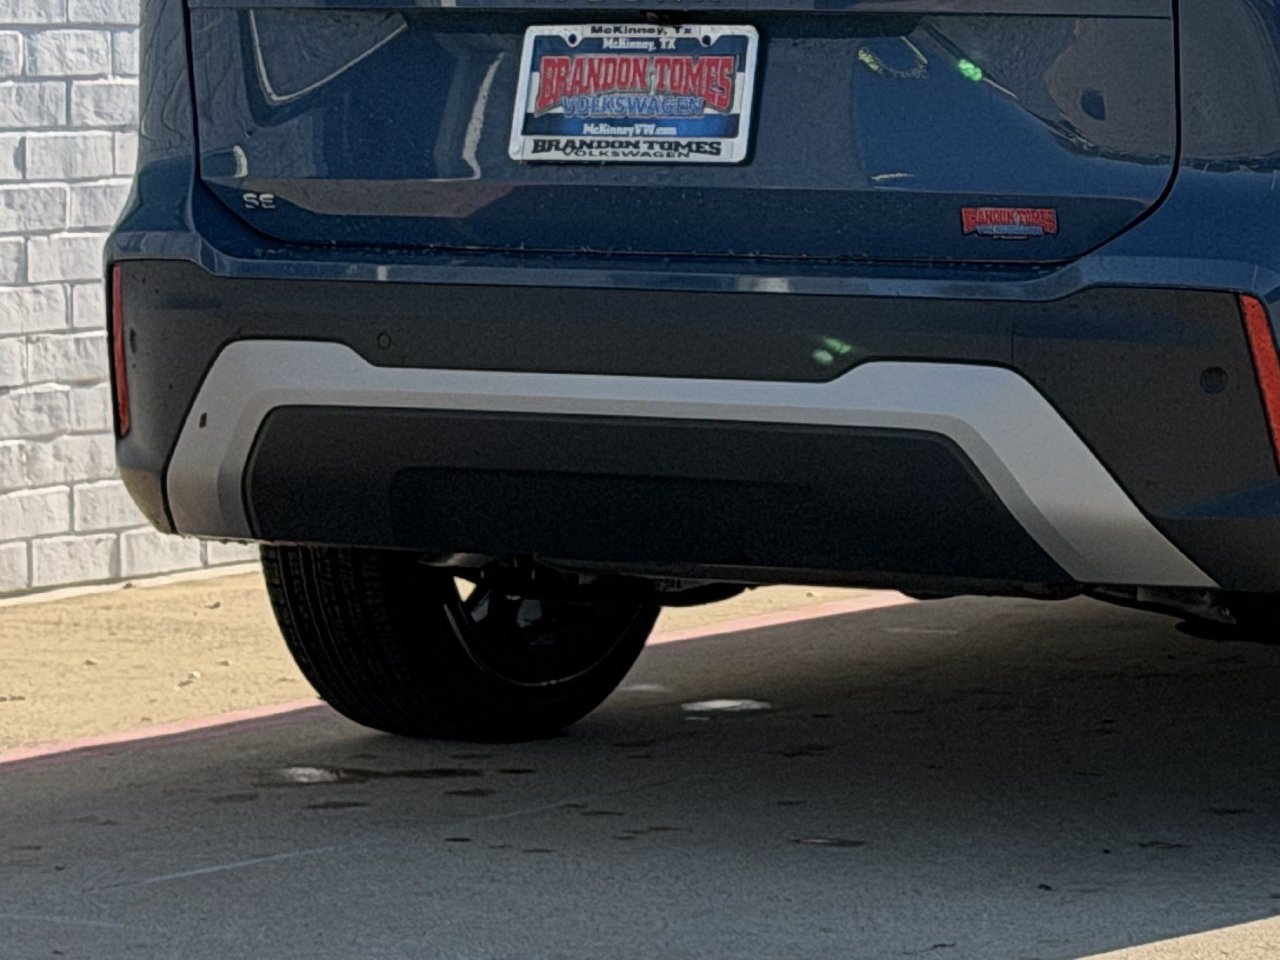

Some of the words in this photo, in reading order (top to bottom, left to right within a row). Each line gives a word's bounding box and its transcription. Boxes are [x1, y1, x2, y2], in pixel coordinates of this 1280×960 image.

[661, 38, 676, 49] TX
[535, 56, 649, 116] BRANDON
[655, 56, 736, 114] TOMES
[562, 95, 704, 117] VOLKSWAGEN
[531, 139, 641, 154] BRANDON
[646, 141, 722, 156] TOMES
[562, 149, 691, 158] VOLKSWAGEN
[242, 192, 277, 209] SE
